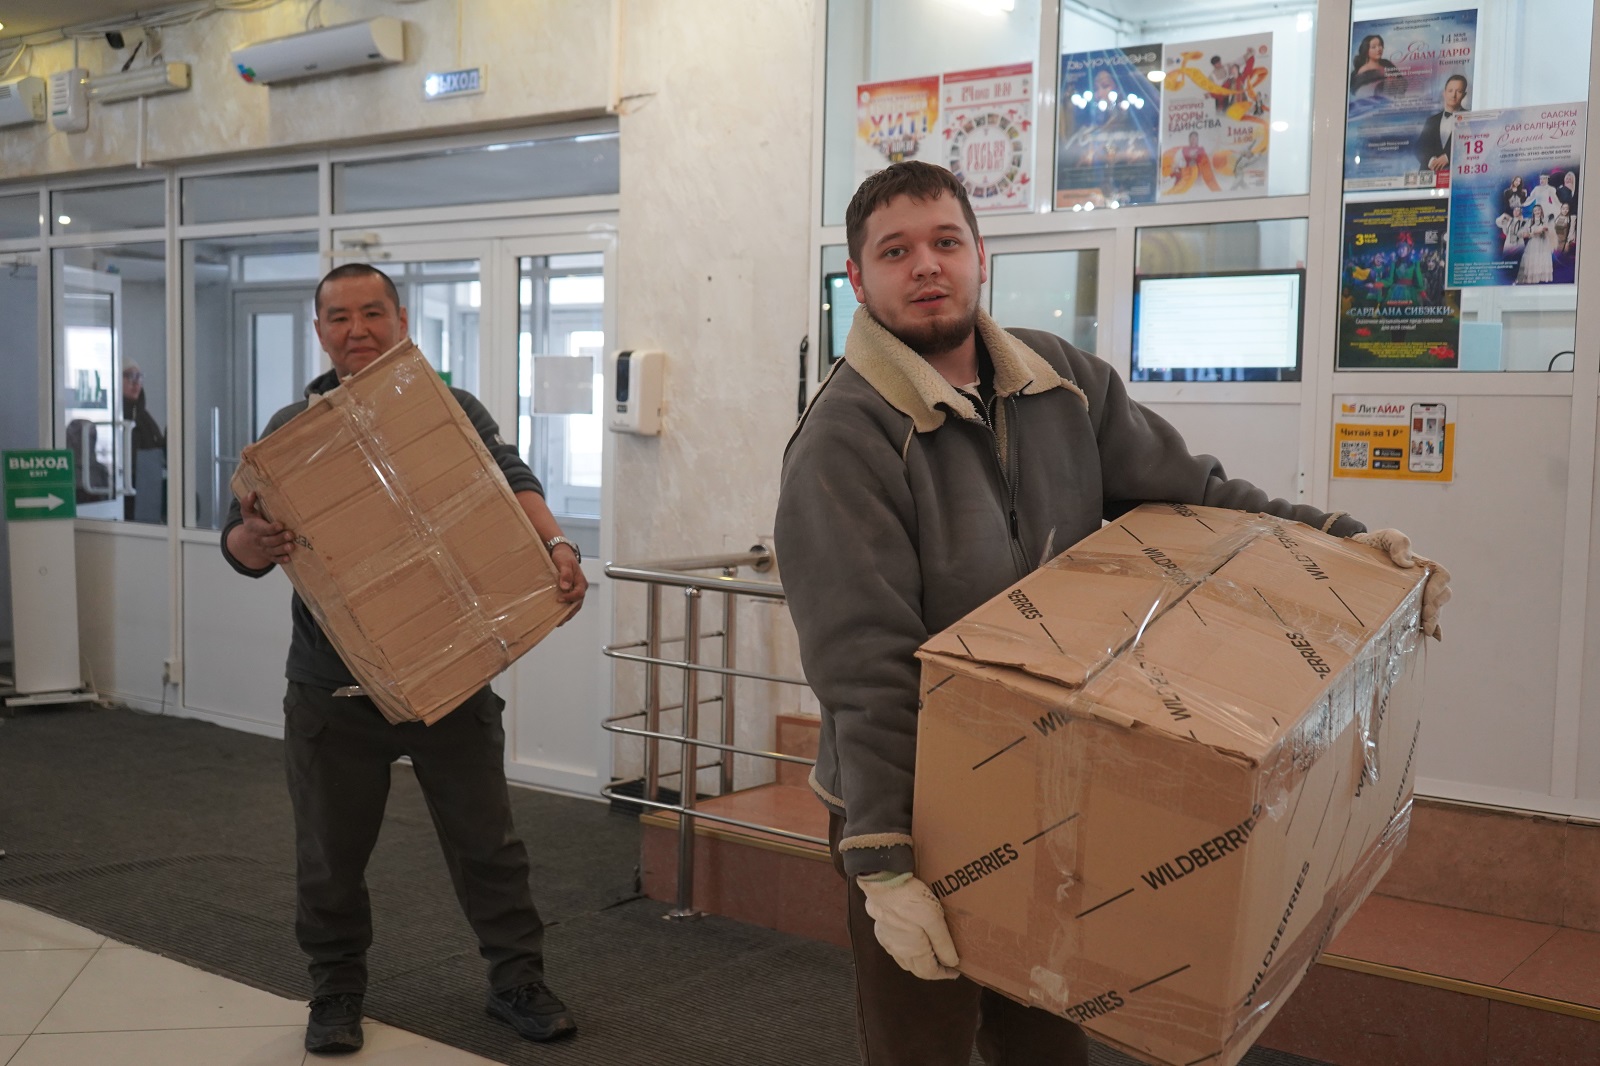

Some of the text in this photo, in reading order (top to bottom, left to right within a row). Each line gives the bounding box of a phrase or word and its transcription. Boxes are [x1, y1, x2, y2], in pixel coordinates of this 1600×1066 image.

[1438, 47, 1471, 59] ДАРЮ
[1439, 59, 1471, 67] Концерт
[427, 71, 479, 95] ЫХОД
[1541, 109, 1578, 120] СААСКЫ
[870, 113, 928, 138] ХИТ!
[1168, 120, 1222, 133] ЕДИНСТВА
[1504, 123, 1522, 133] САЙ
[1464, 139, 1484, 155] 18
[1457, 163, 1488, 175] 18:30
[1355, 233, 1364, 246] 3
[1358, 402, 1406, 415] ЛитАЙАР
[1340, 427, 1372, 437] Читай
[9, 456, 69, 471] ВЫХОД
[29, 469, 48, 478] EXIT
[1140, 803, 1262, 890] WILDBERRIES
[1243, 860, 1310, 1008] WILDBERRIES
[1061, 990, 1125, 1023] ERRIES
